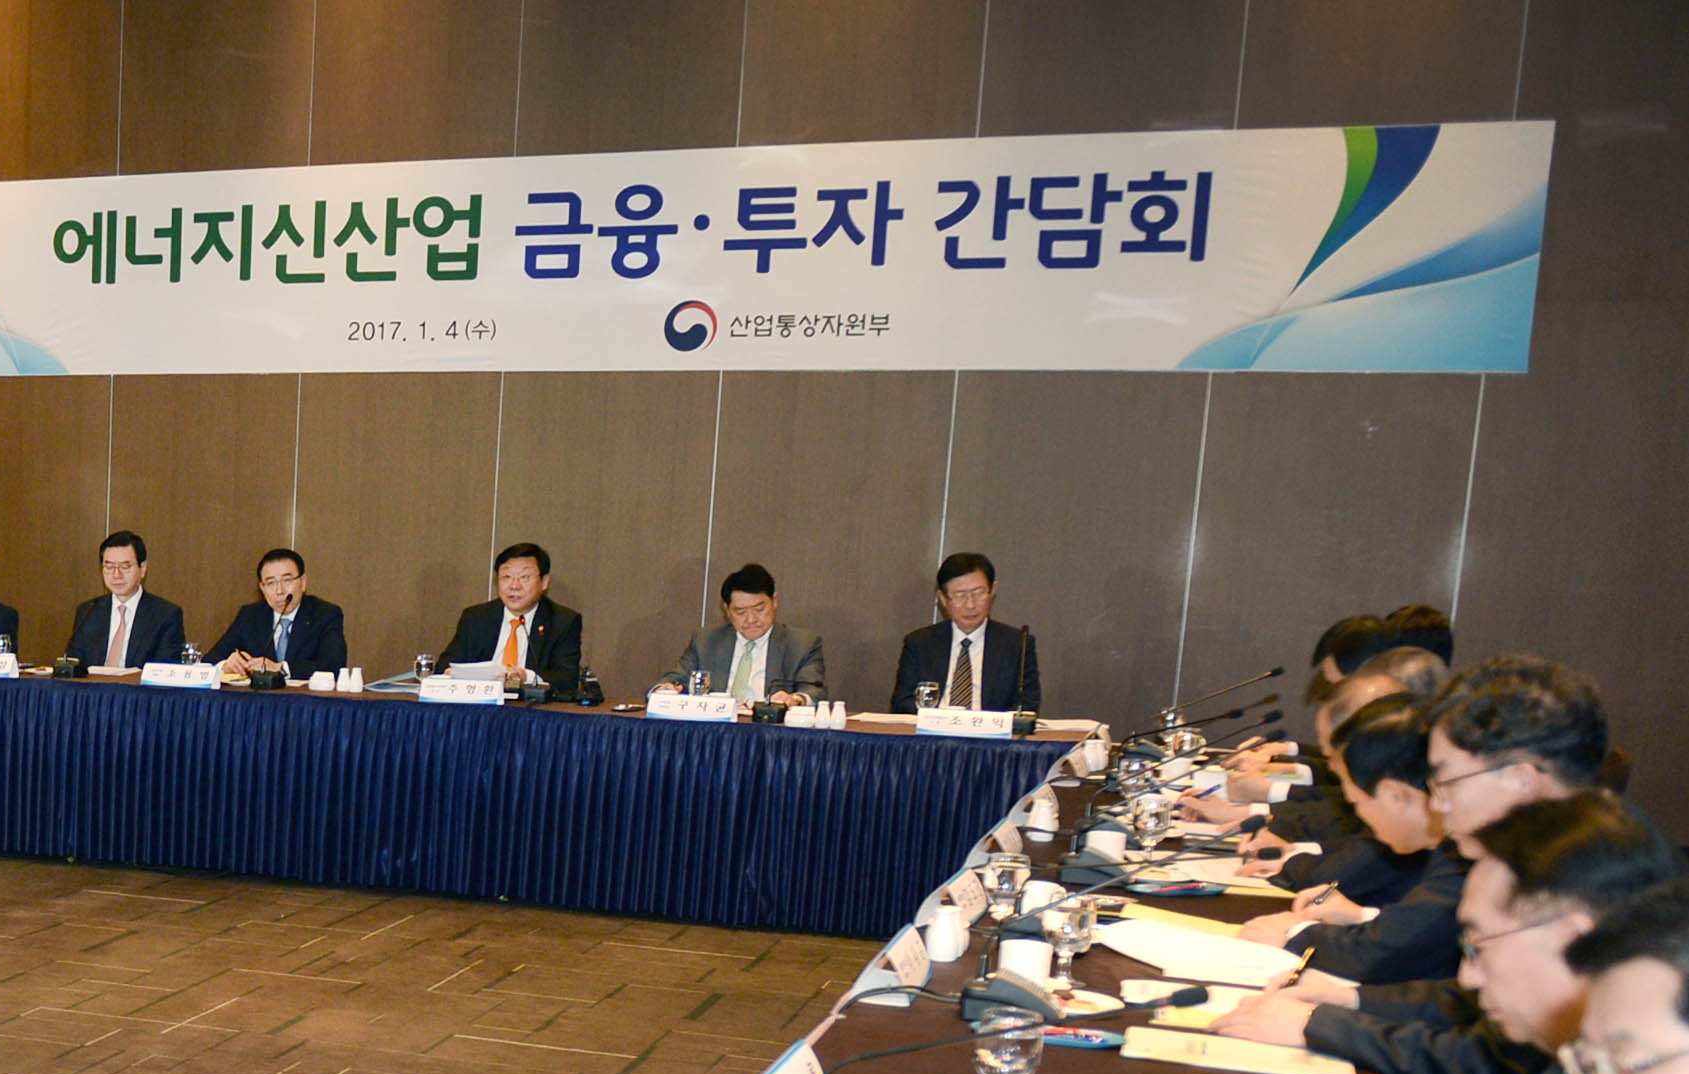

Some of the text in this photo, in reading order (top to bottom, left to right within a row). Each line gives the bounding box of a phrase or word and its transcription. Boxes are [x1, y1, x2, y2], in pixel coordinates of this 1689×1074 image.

[52, 169, 1214, 286] 에너지신산업 금융·투자 간담회
[347, 320, 408, 343] 2017.
[417, 320, 436, 342] 1.
[728, 311, 892, 339] 산업통상자원부
